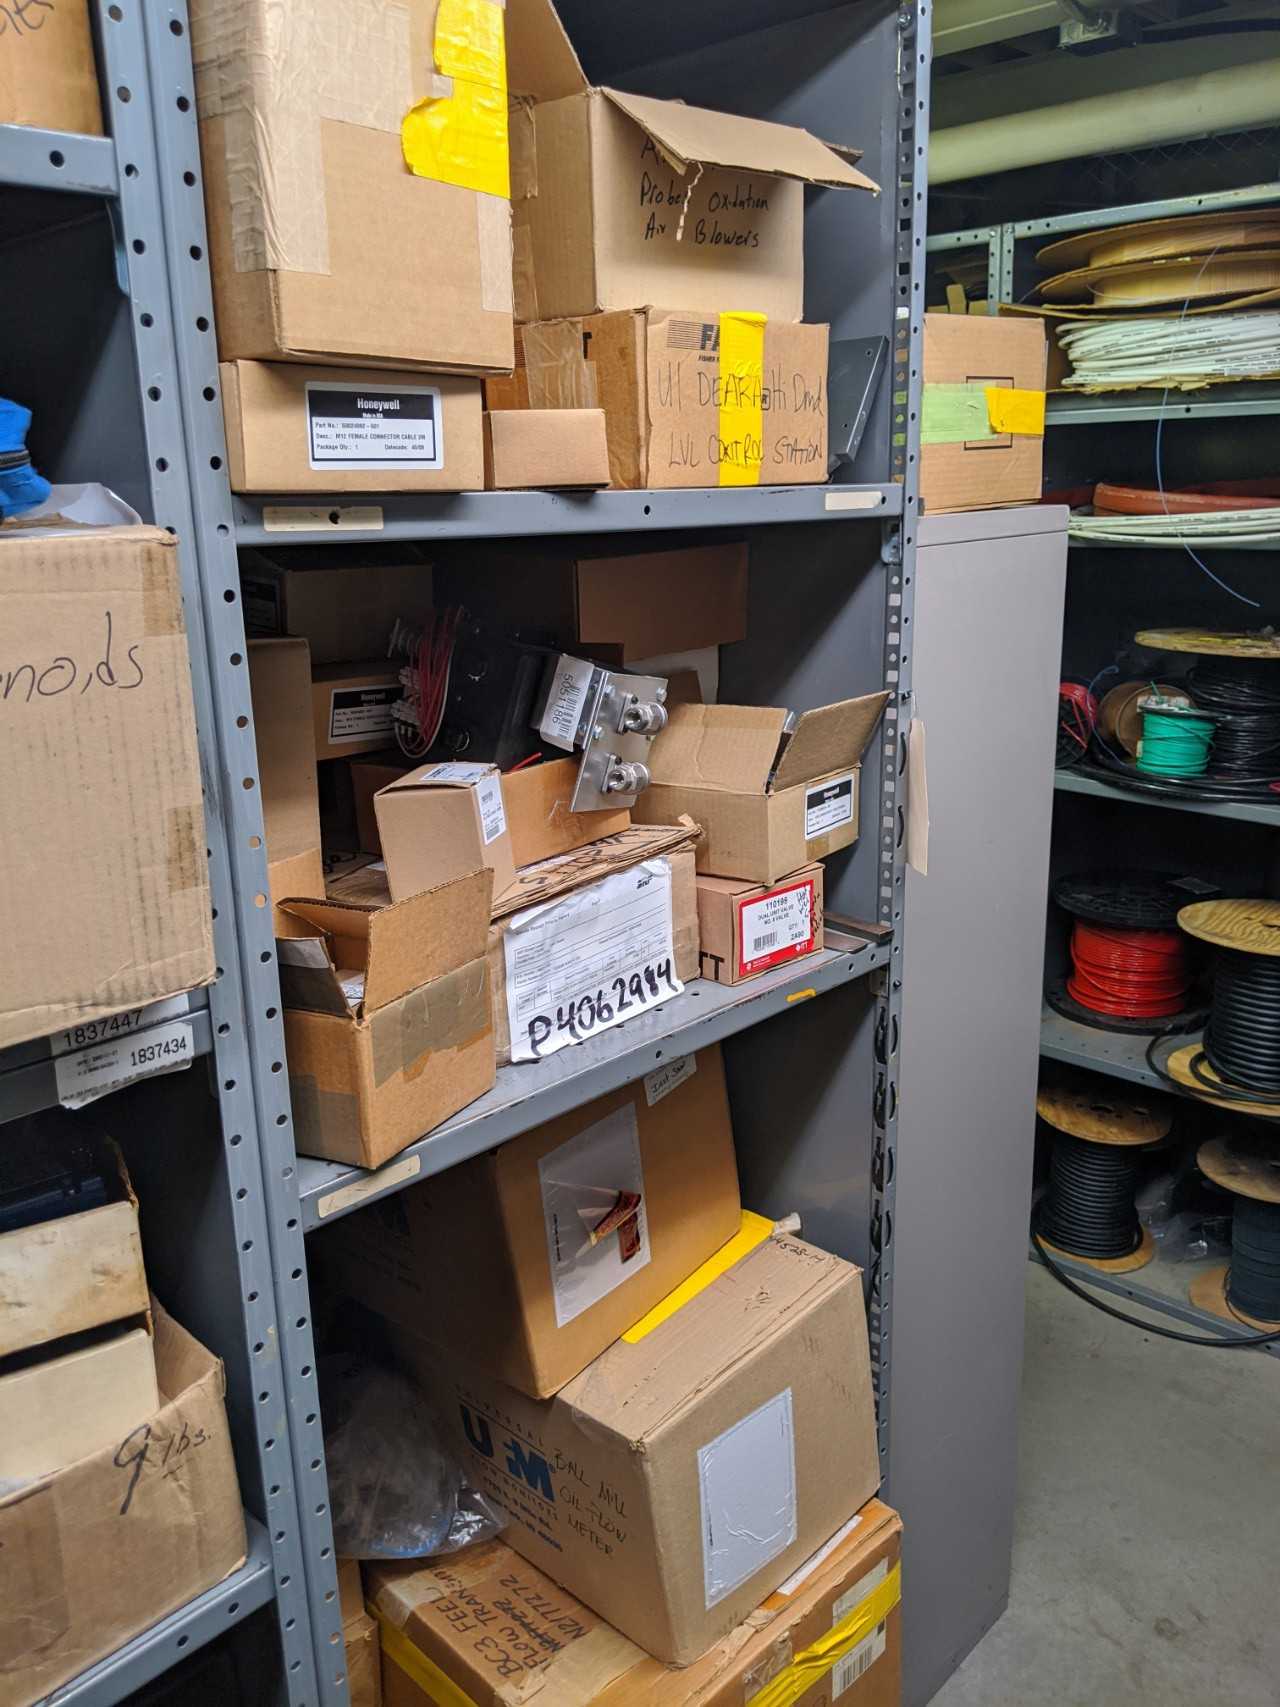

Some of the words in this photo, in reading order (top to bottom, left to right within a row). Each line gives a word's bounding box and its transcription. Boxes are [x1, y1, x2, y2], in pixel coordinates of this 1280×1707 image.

[708, 183, 769, 213] Oxidation
[644, 211, 666, 240] Air
[694, 218, 760, 248] Blowers
[357, 397, 401, 412] Honeywell
[772, 432, 824, 467] STATION
[0, 611, 144, 703] noids
[527, 957, 679, 1057] P4062984
[63, 1009, 144, 1048] 1837447
[130, 1035, 188, 1067] 1837434
[473, 1635, 524, 1677] BC3
